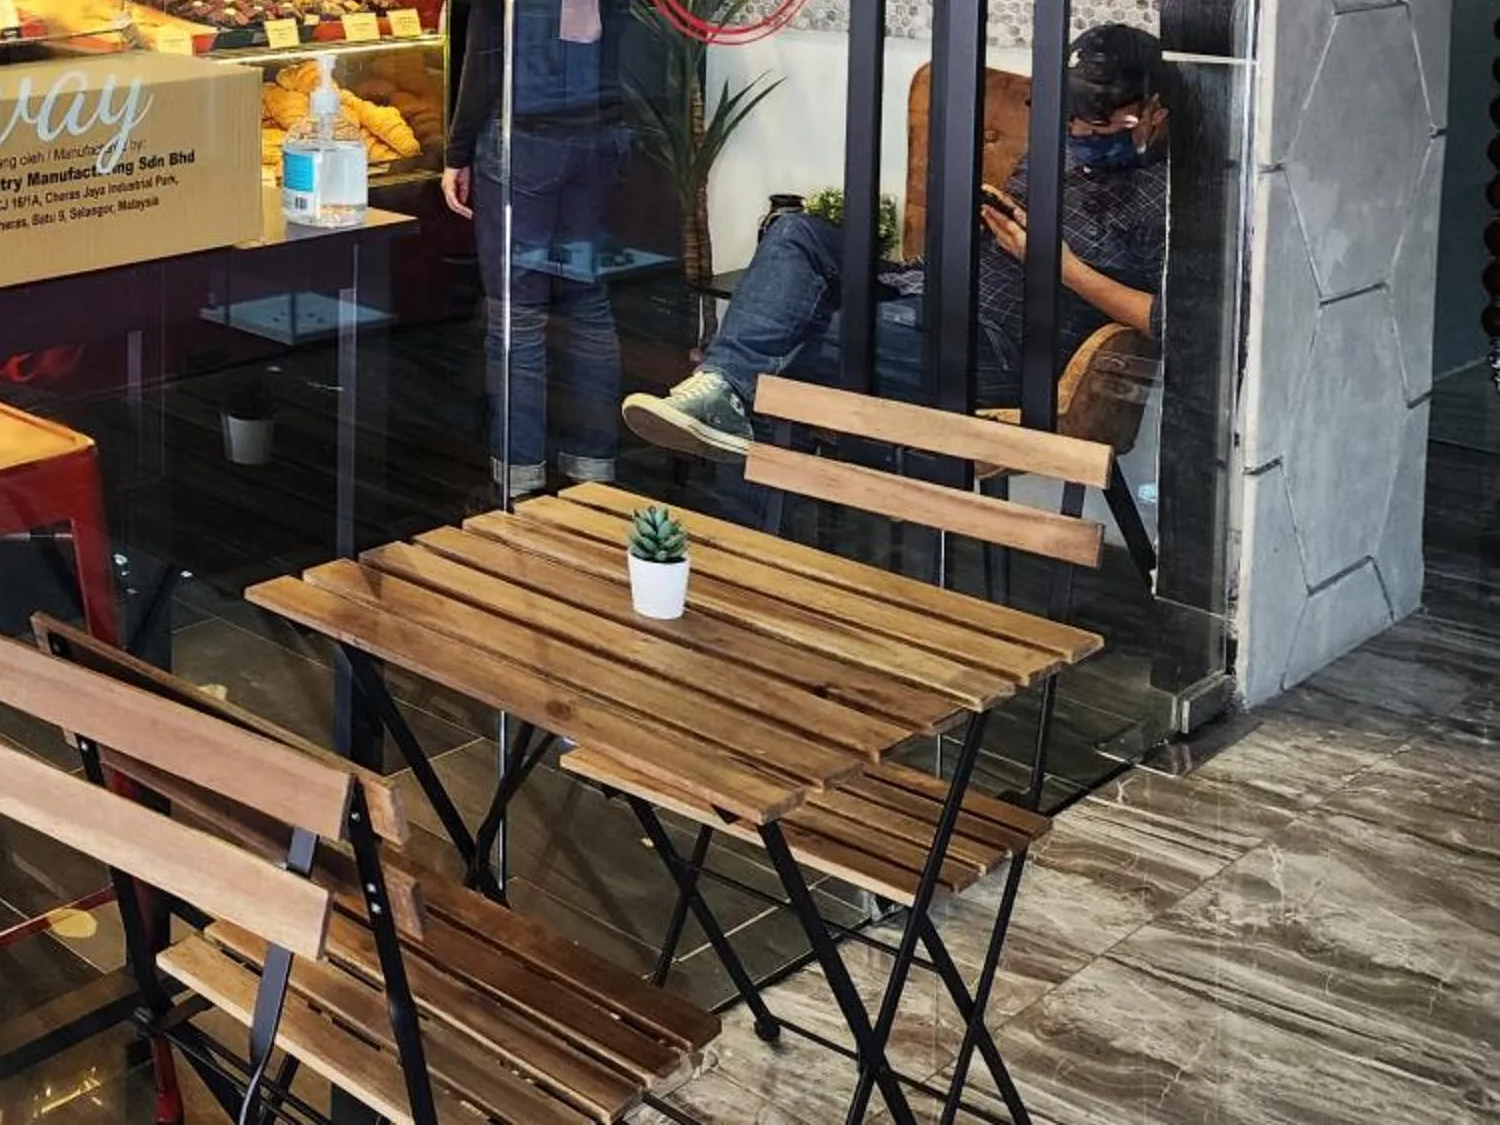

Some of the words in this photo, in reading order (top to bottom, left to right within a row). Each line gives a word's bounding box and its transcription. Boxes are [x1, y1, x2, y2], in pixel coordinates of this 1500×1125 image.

[139, 153, 165, 169] Sdn
[169, 150, 196, 166] Bhd
[45, 188, 80, 204] Cheras
[83, 185, 106, 201] Jaya
[108, 177, 153, 195] Industrial
